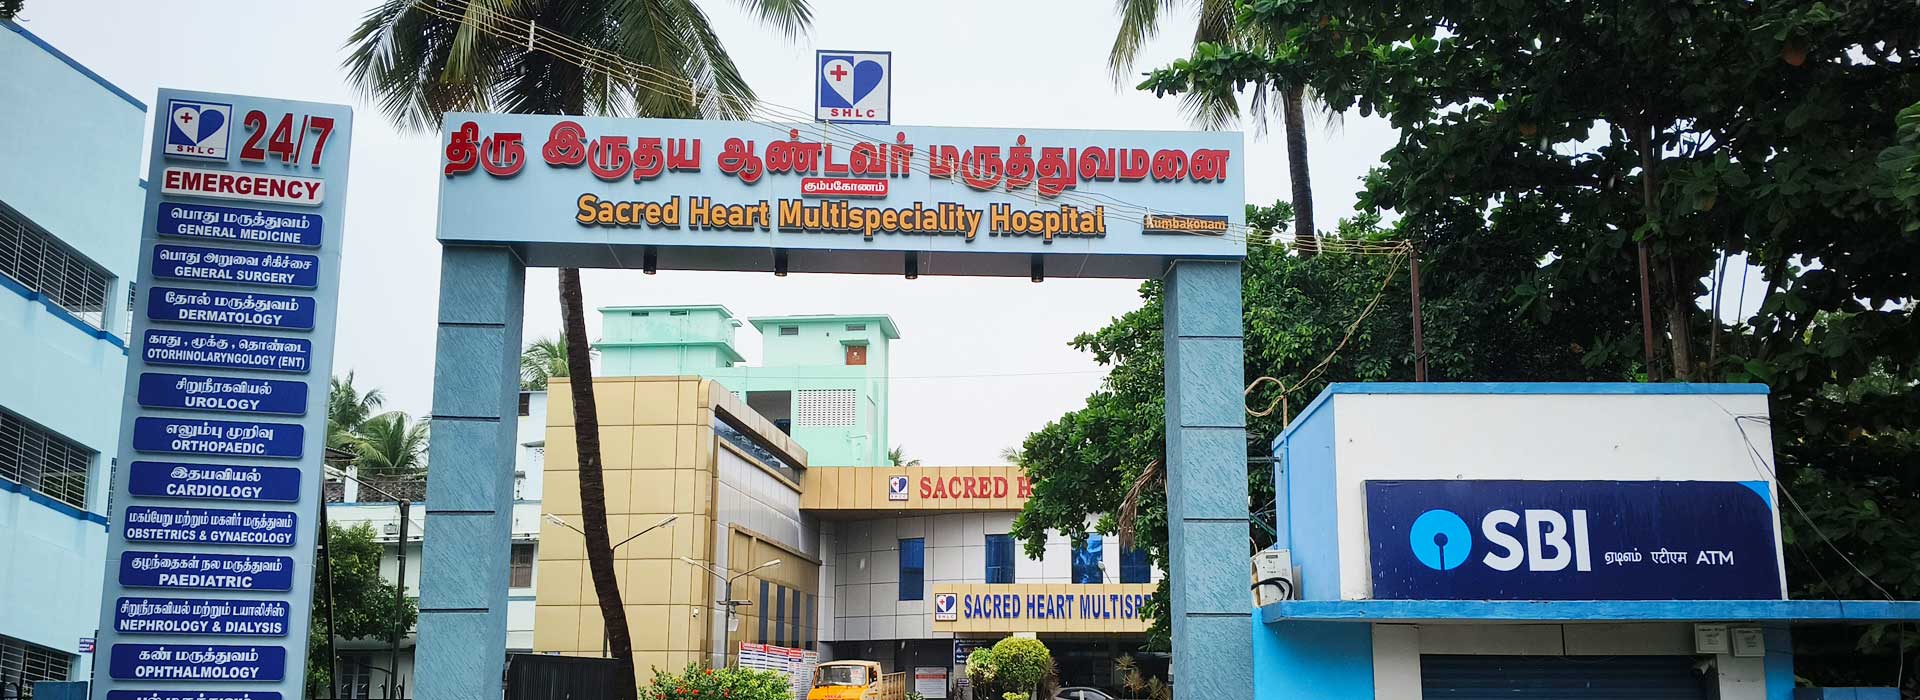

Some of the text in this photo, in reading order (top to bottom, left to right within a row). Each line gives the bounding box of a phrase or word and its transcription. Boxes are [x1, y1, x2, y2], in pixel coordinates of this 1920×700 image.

[830, 108, 876, 118] SHLC
[240, 109, 335, 168] 24/7
[176, 144, 216, 155] SHLC
[444, 121, 1231, 196] திரு இருதய ஆண்டவர் மருத்துவமனை
[165, 170, 320, 200] EMERGENCY
[804, 181, 886, 193] கும்பகோணம்
[170, 207, 310, 230] பொது மருத்துவம்
[577, 194, 1106, 243] Sacred Heart Multispeciality Hospital
[177, 223, 301, 244] GENERAL MEDICINE
[160, 250, 313, 271] பொது அறுவை சிகிச்சை
[174, 266, 296, 284] GENERAL SURGERY
[165, 291, 299, 312] தோல் மருத்துவம்
[178, 309, 283, 326] DERMATOLOGY
[149, 334, 182, 348] காது
[191, 335, 229, 349] மூக்கு
[238, 338, 306, 353] தொண்டை
[147, 348, 305, 370] OTORHINOLARYNGOLOGY (ENT)
[176, 377, 273, 395] சிறுநீரகவியல்
[184, 396, 260, 411] UROLOGY
[166, 421, 274, 440] எலும்பு முறிவு
[171, 439, 265, 454] ORTHOPAEDIC
[170, 466, 261, 483] இதயவியல்
[166, 483, 263, 498] CARDIOLOGY
[920, 476, 1032, 499] SACRED H
[129, 509, 173, 526] மகப்பேறு
[174, 510, 209, 528] மற்றும்
[243, 513, 293, 531] மருத்துவம்
[127, 528, 292, 544] OBSTETRICS & GYNAECOLOGY
[1481, 509, 1592, 571] SBI
[131, 554, 283, 574] குழந்தைகள் நல மருத்துவம்
[1605, 548, 1734, 566] ஏடிஎம் एटीएम ATM
[159, 573, 253, 588] PAEDIATRIC
[120, 599, 285, 619] சிறுநீரகவியல் மற்றும் டயாலிசிஸ்
[964, 594, 1021, 619] SACRED
[1027, 594, 1074, 619] HEART
[120, 620, 282, 633] NEPHROLOGY & DIALYSIS
[138, 646, 259, 665] கண் மருத்துவம்
[135, 665, 260, 679] OPHTHALMOLOGY
